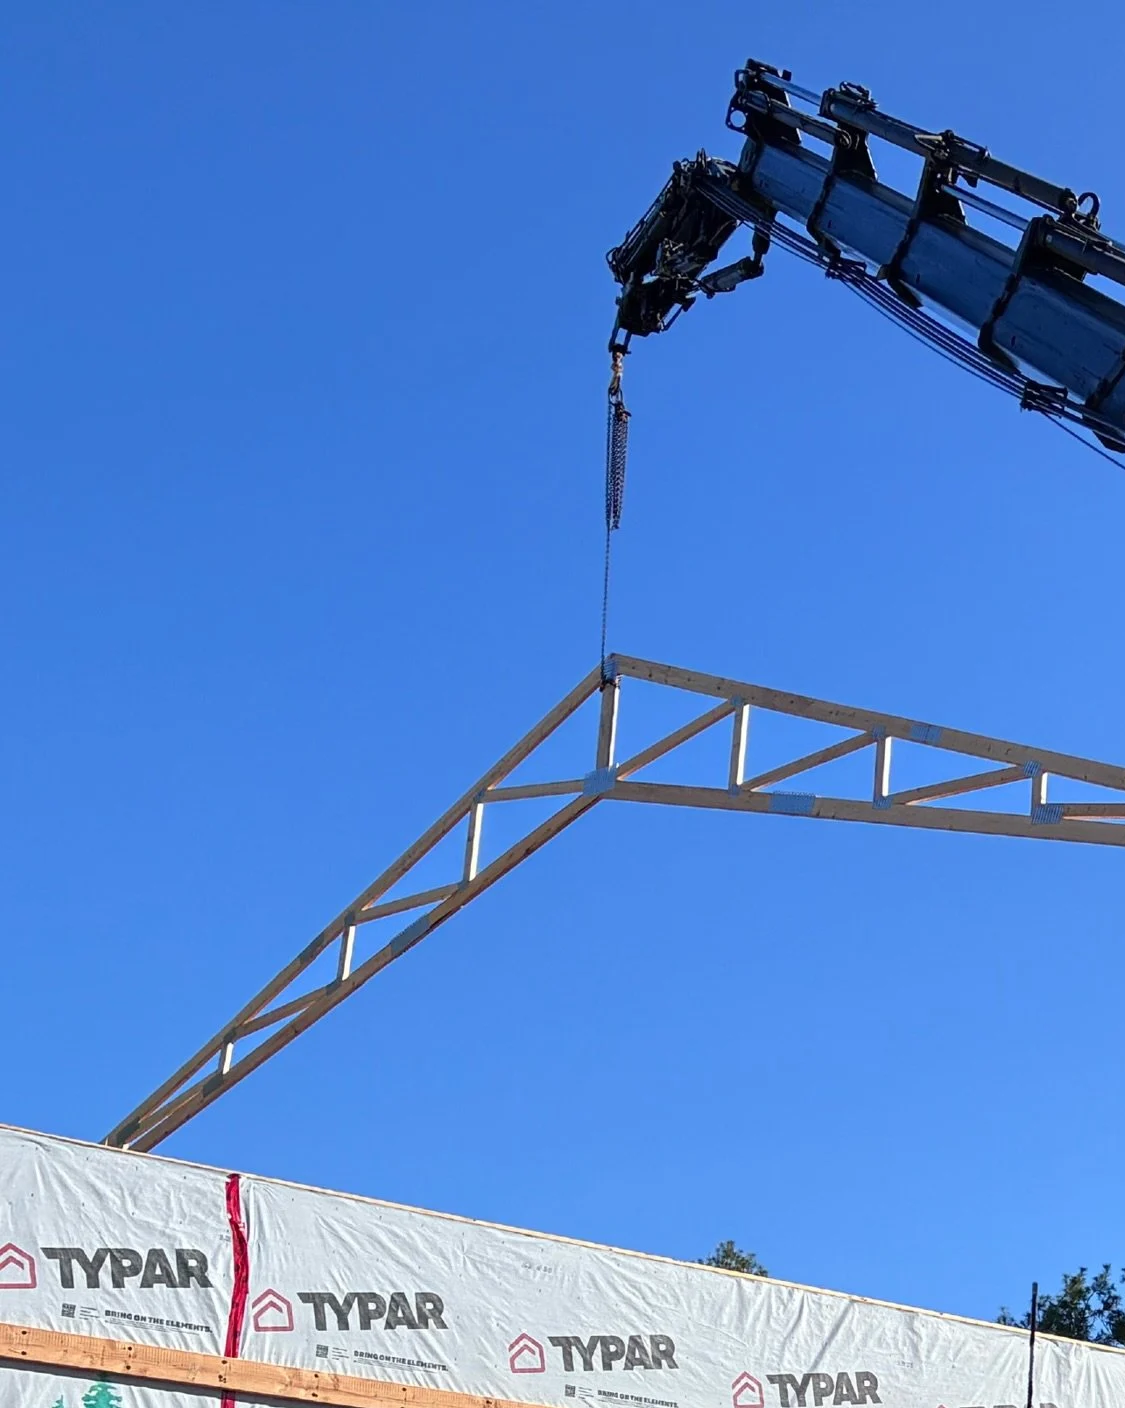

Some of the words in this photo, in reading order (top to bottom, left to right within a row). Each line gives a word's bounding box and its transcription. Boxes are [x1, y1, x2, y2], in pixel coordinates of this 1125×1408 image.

[40, 1247, 214, 1289] TYPAR
[133, 1313, 148, 1322] ON
[148, 1315, 164, 1325] THE
[296, 1291, 449, 1332] TYPAR
[547, 1334, 680, 1372] TYPAR
[765, 1370, 883, 1408] TYPAR
